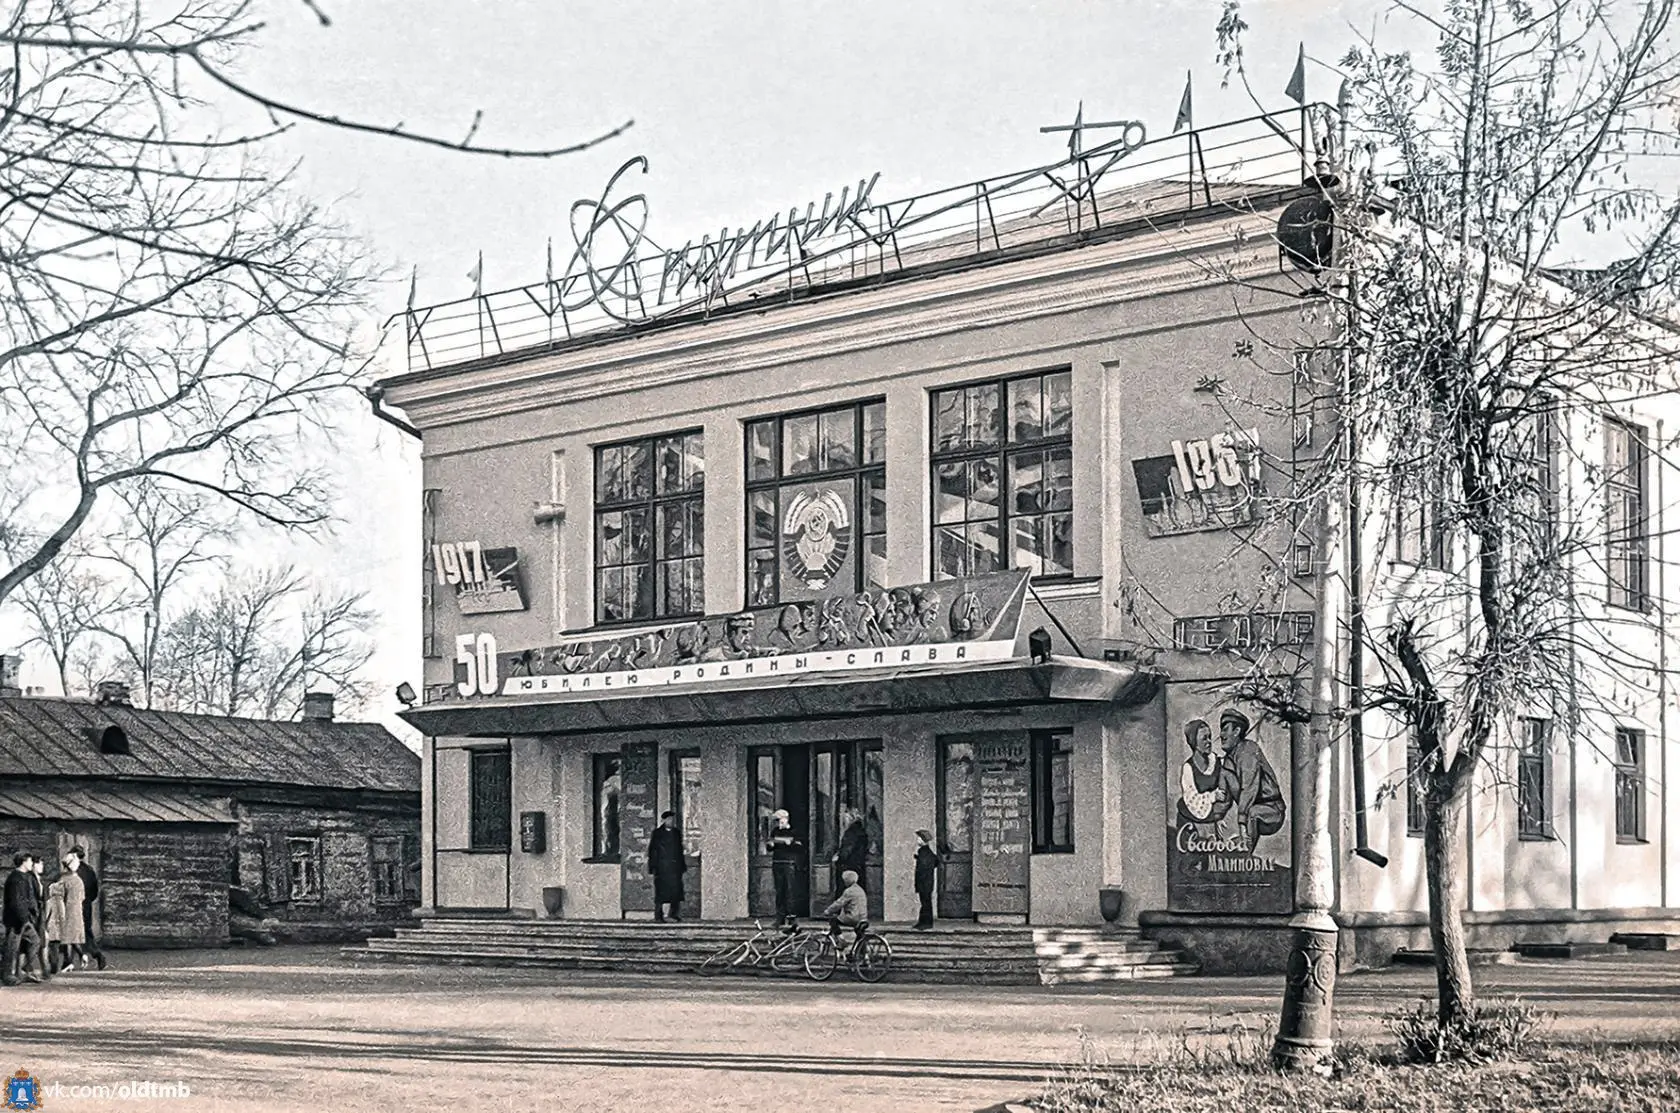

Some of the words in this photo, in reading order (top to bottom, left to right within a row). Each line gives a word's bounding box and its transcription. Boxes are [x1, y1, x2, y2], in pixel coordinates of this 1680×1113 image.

[432, 540, 481, 585] 1917
[456, 633, 498, 697] 50
[520, 673, 638, 690] ЮБИЛЕЮ
[847, 645, 966, 665] СЛАВА
